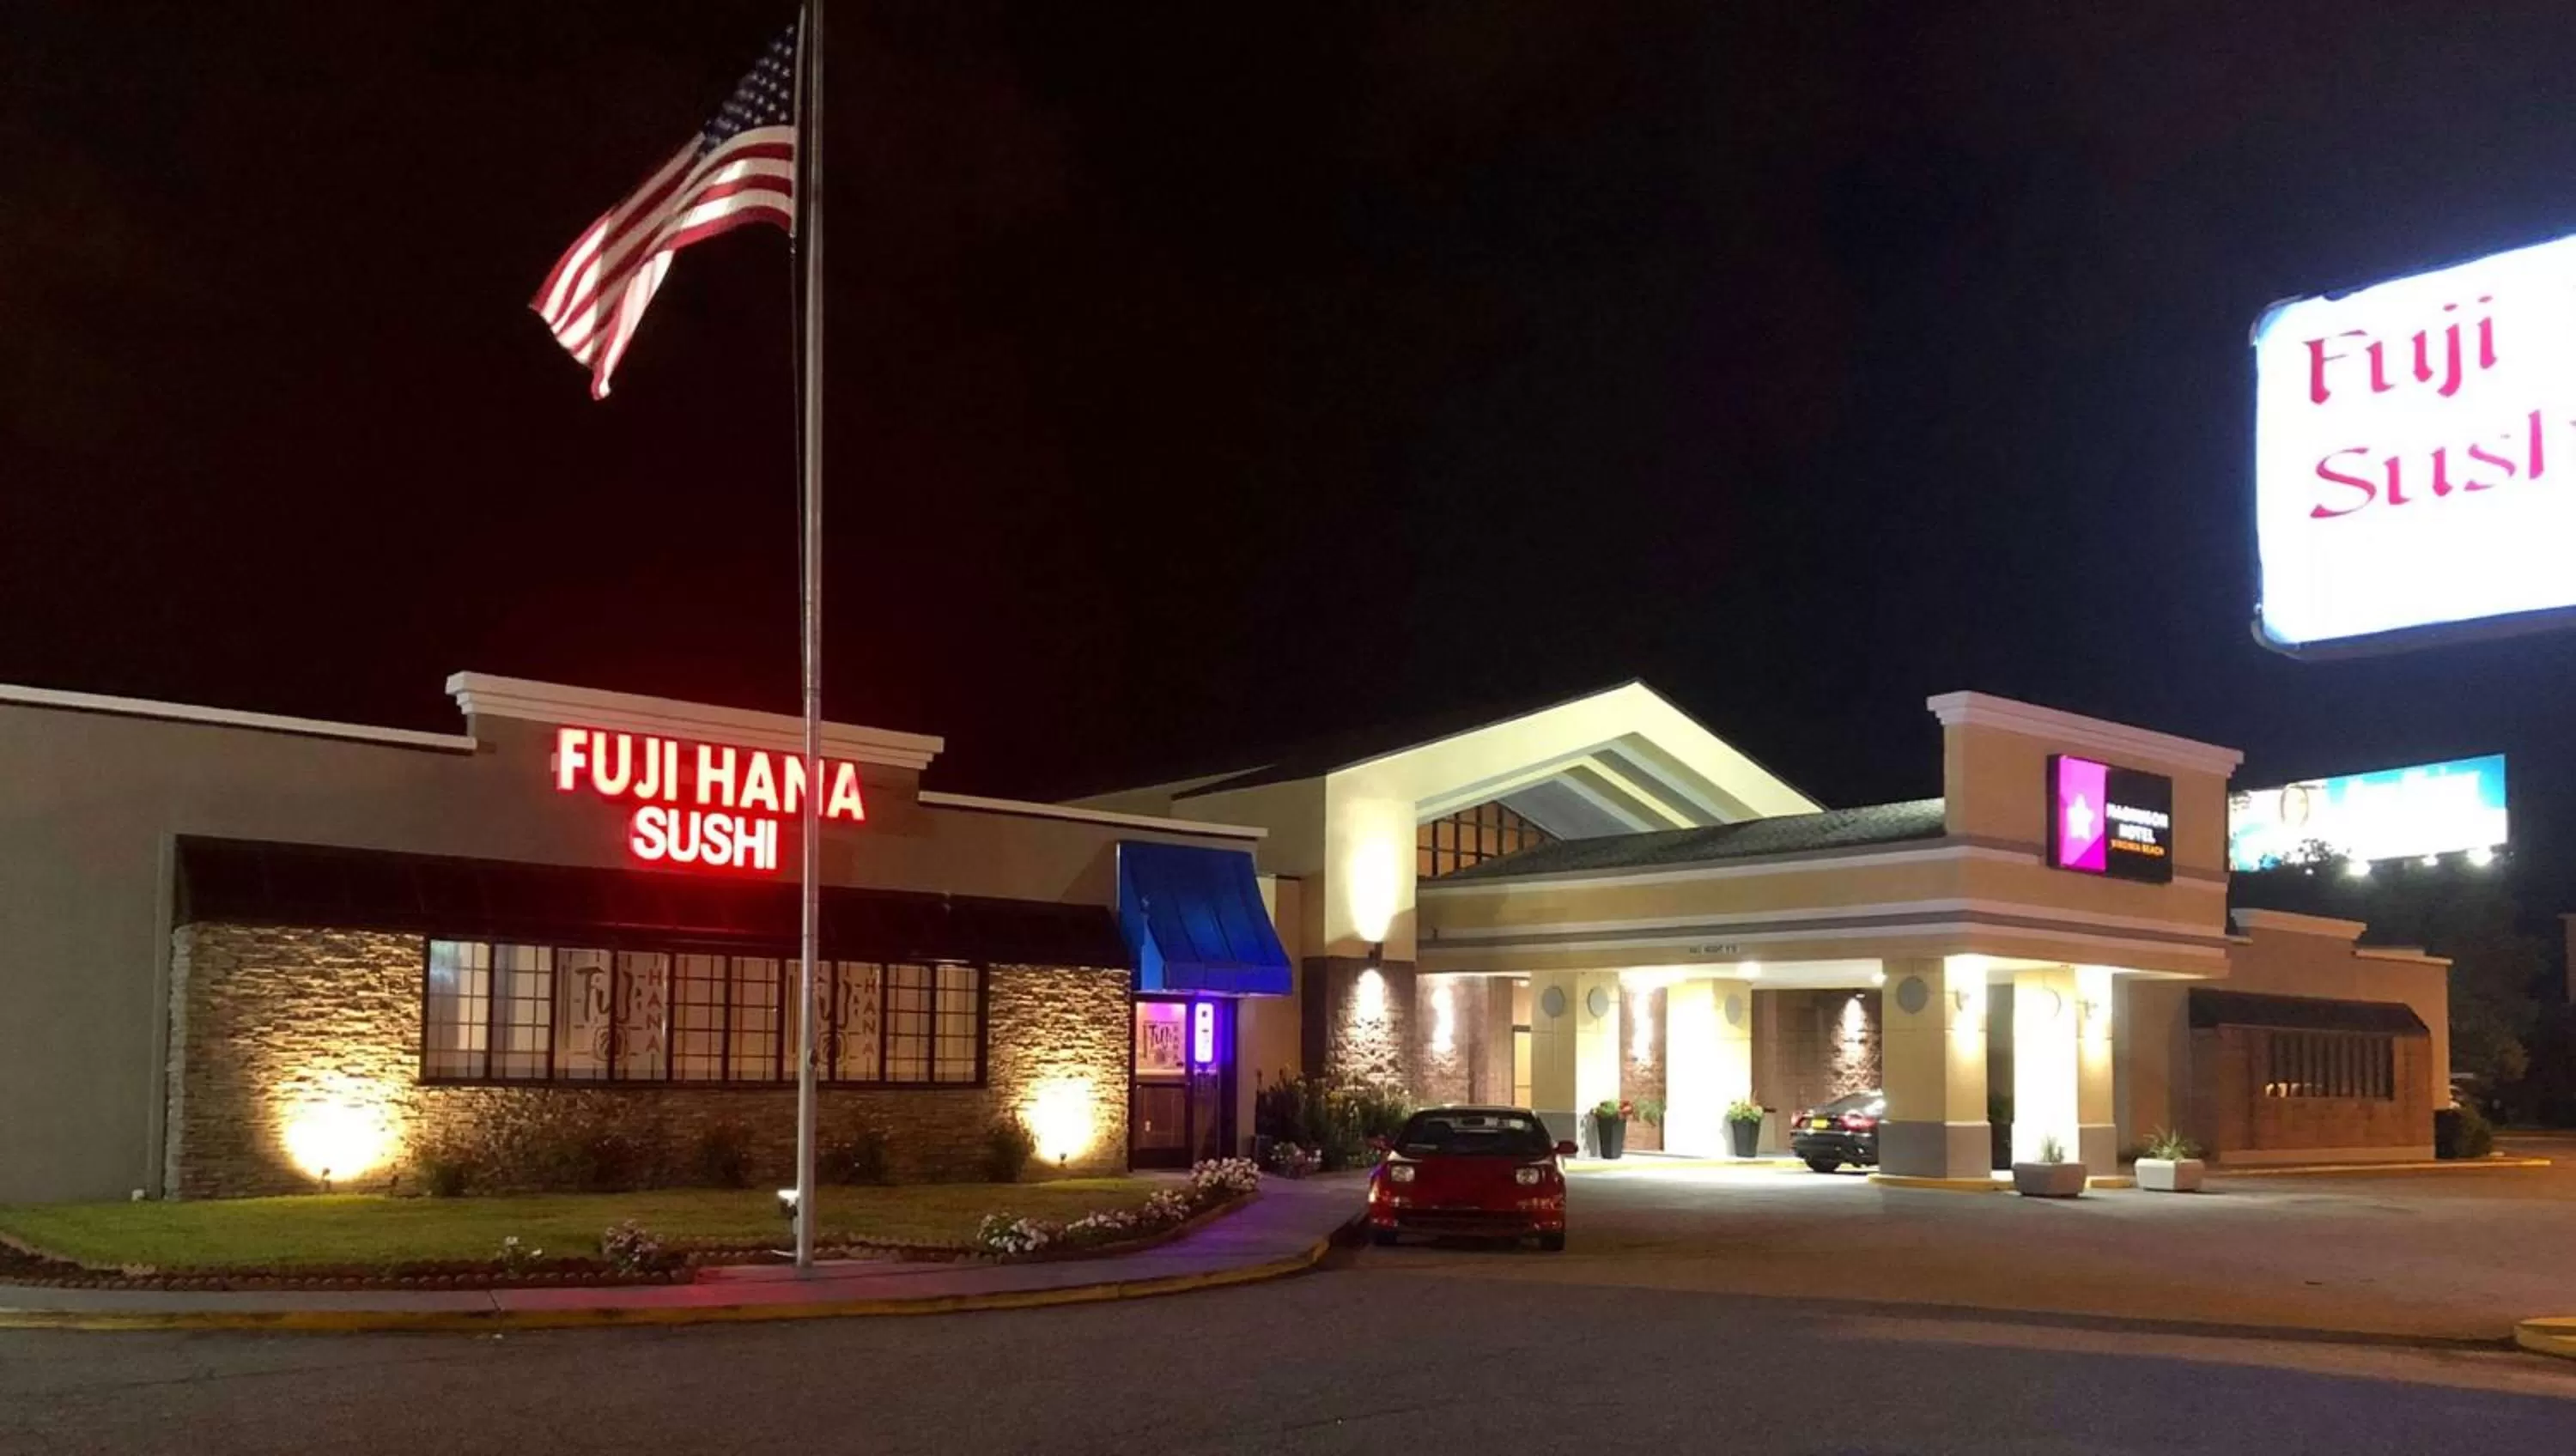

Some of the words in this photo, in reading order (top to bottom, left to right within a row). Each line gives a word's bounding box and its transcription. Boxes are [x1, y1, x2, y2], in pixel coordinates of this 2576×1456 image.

[2301, 294, 2500, 406] Fuji
[558, 728, 677, 801] FUJI
[696, 745, 866, 821] HANA
[633, 806, 778, 870] SUSHI
[645, 968, 662, 1053] HANA
